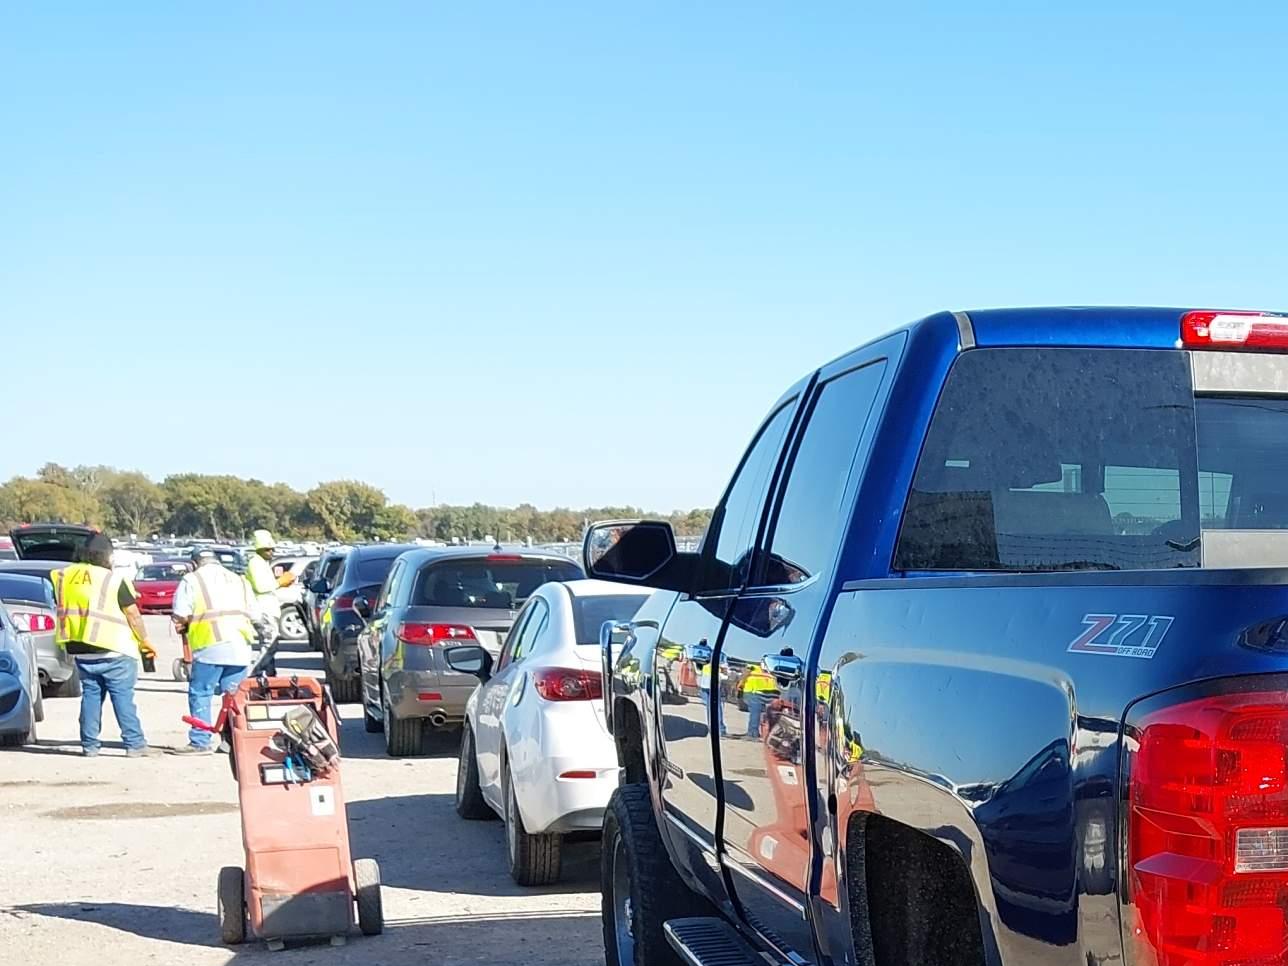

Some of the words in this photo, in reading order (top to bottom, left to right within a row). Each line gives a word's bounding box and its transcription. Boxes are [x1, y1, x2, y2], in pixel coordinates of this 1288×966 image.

[1066, 613, 1175, 656] Z71
[1117, 647, 1132, 655] OFF
[1132, 648, 1154, 657] ROAD
